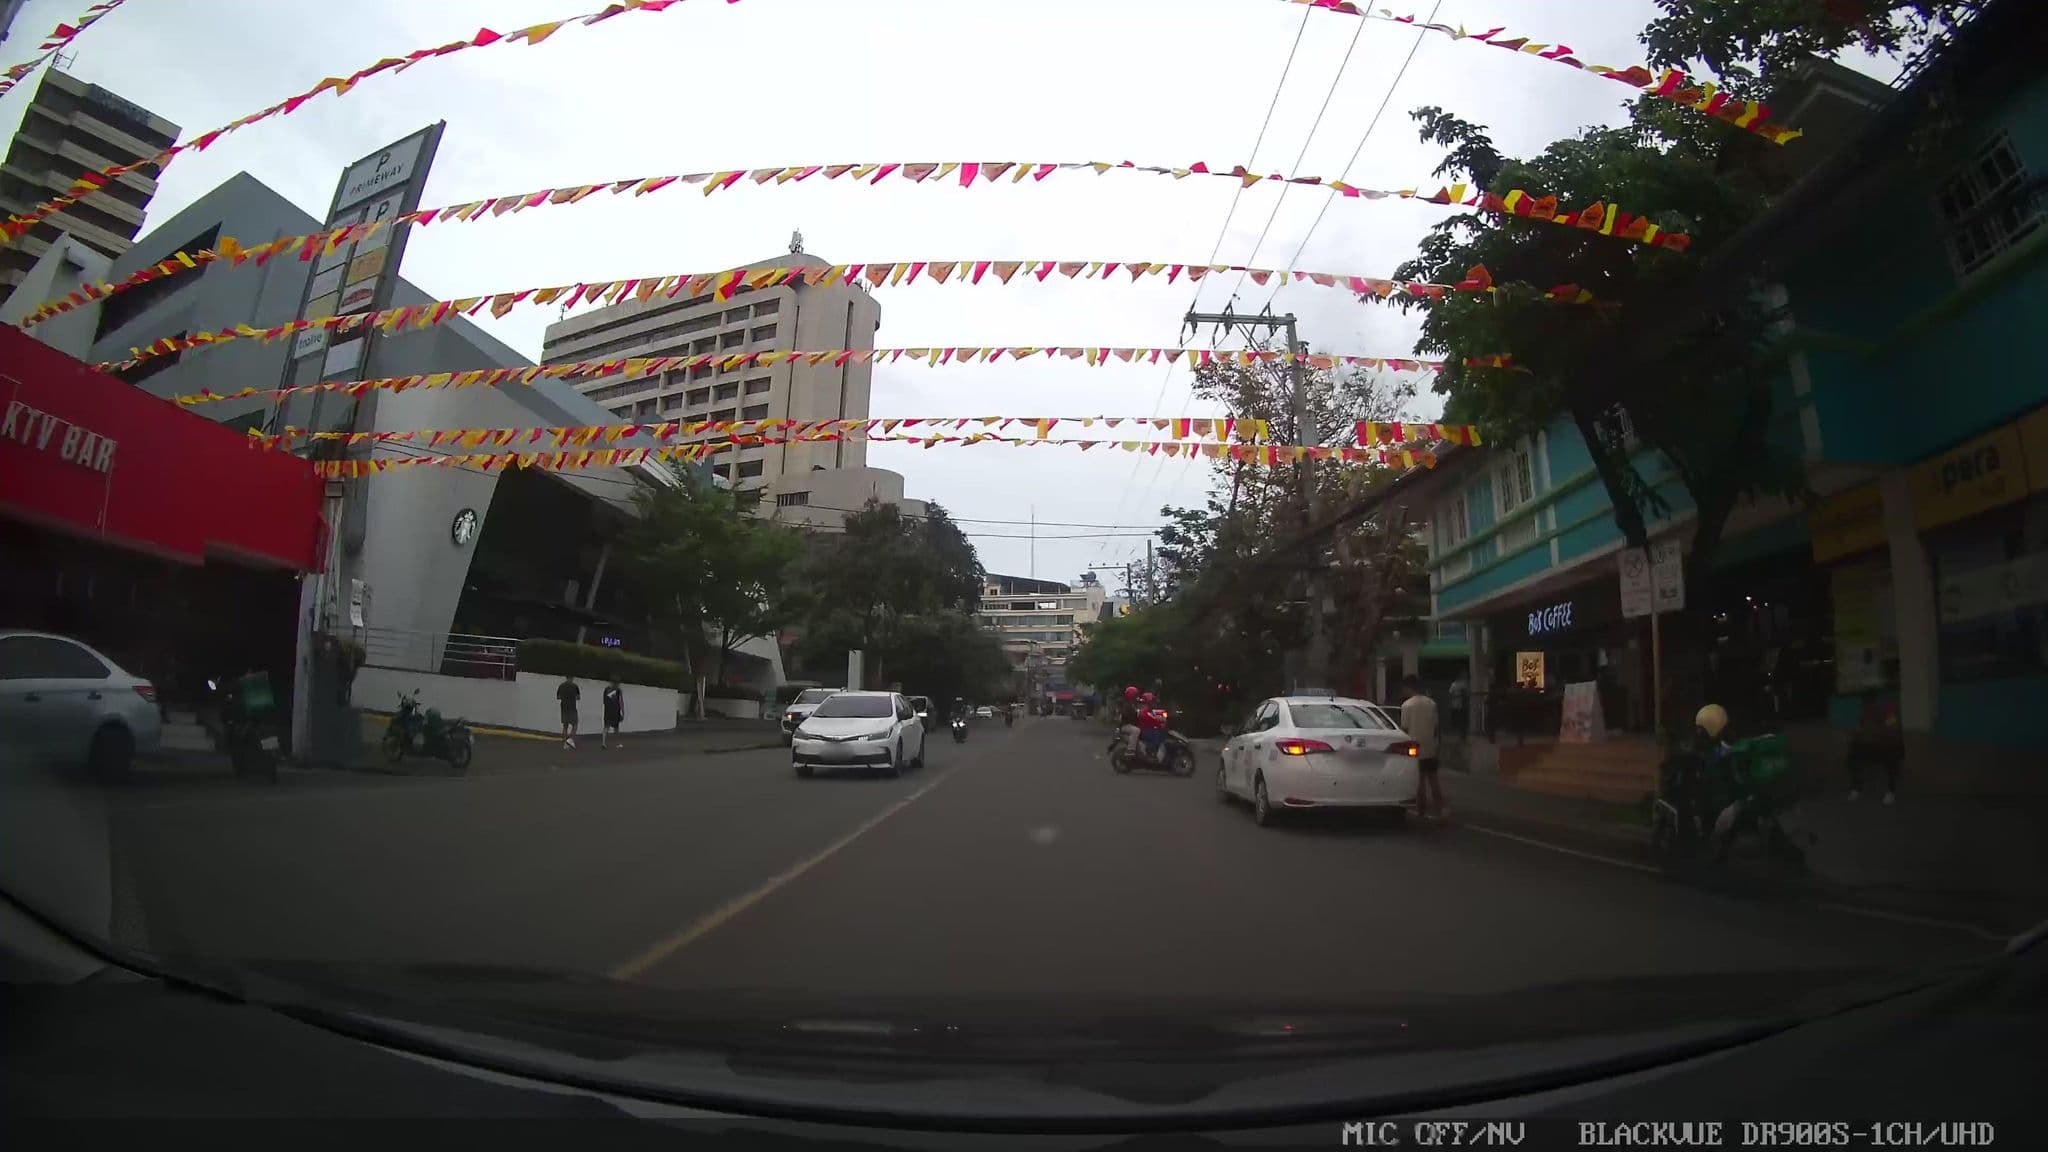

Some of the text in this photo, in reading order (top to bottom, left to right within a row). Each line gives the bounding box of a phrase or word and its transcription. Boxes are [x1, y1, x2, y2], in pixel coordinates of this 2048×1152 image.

[350, 163, 404, 194] PRIMEWAY
[0, 401, 116, 473] KTV BAR
